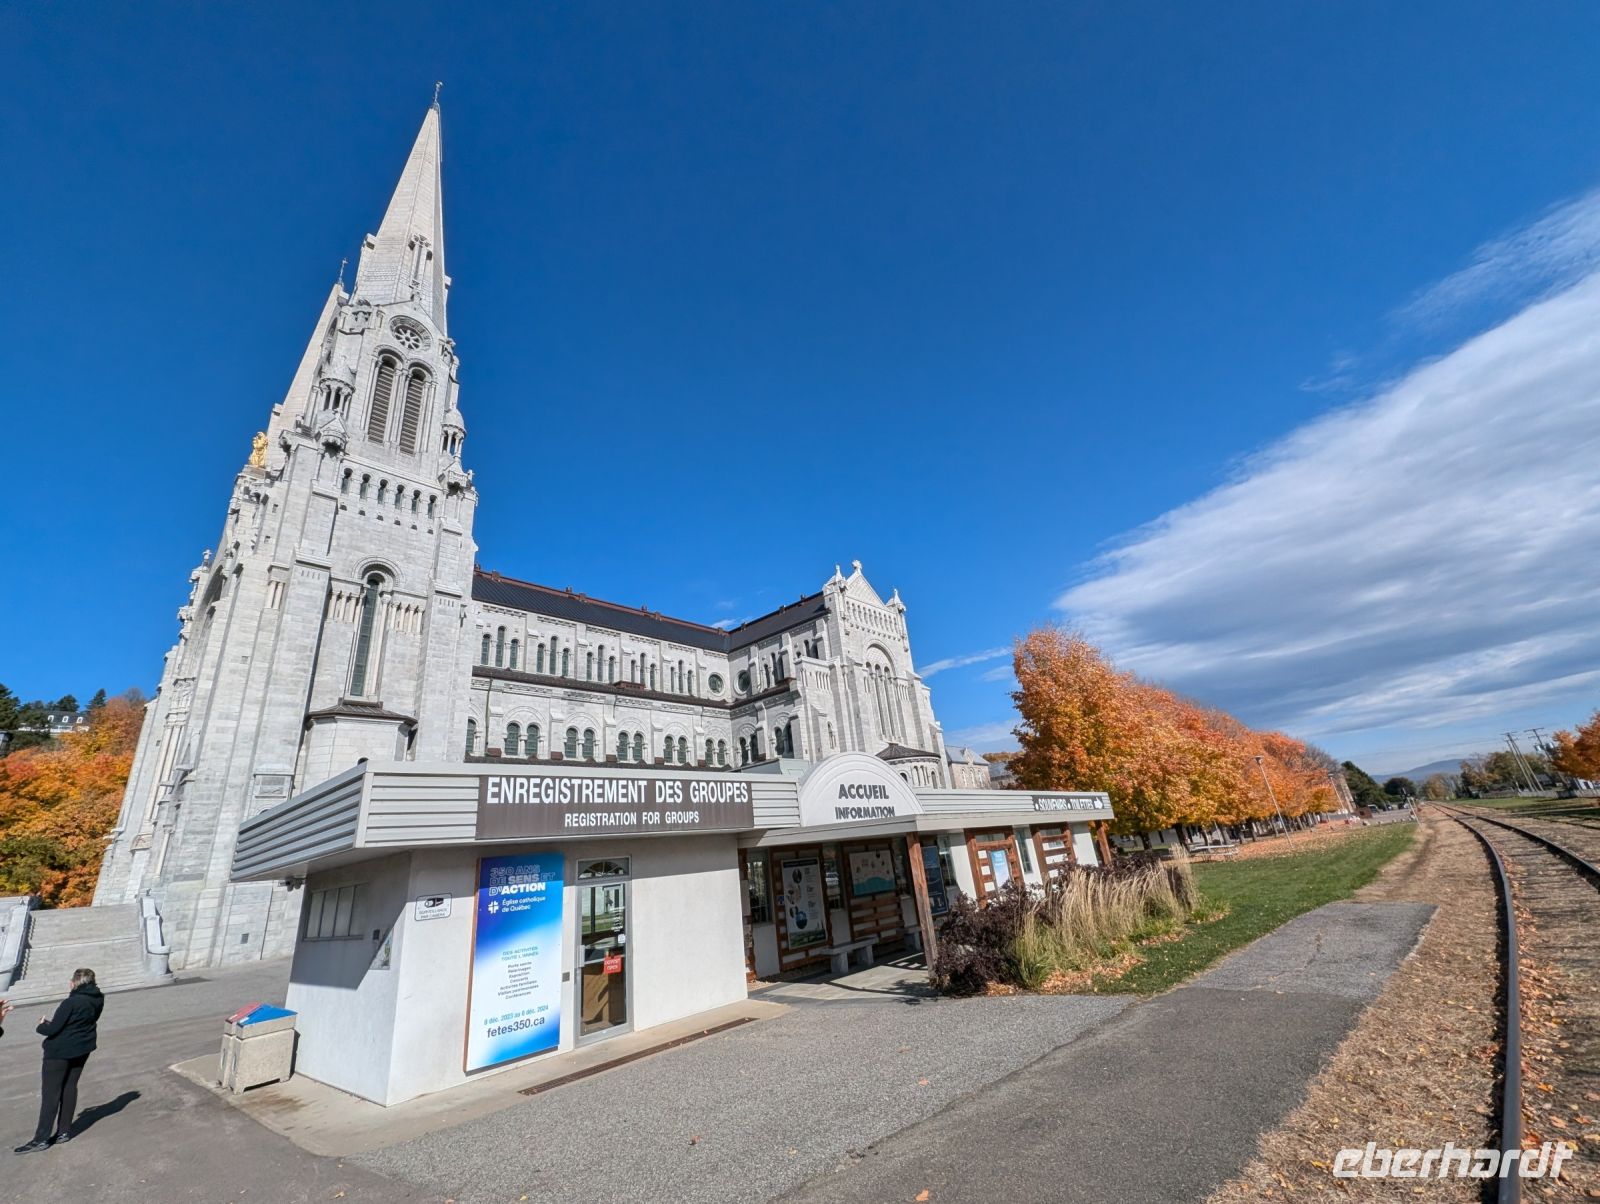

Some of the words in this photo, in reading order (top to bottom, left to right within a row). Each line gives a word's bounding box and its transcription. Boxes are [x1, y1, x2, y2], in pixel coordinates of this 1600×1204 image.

[487, 777, 647, 804] ENREGISTREMENT
[655, 780, 683, 804] DES
[690, 781, 748, 804] GROUPES
[838, 783, 890, 800] ACCUEIL
[564, 812, 637, 828] REGISTRATION
[642, 811, 660, 825] FOR
[665, 810, 700, 825] GROUPS
[835, 806, 896, 820] INFORMATION
[490, 867, 514, 877] 350
[515, 864, 541, 875] ANS
[489, 876, 507, 886] DE
[508, 874, 540, 884] SENS
[540, 872, 556, 881] ET
[489, 882, 546, 896] D'ACTION
[502, 898, 518, 906] Église
[510, 904, 531, 912] Québec
[487, 1017, 545, 1038] fetes350.ca
